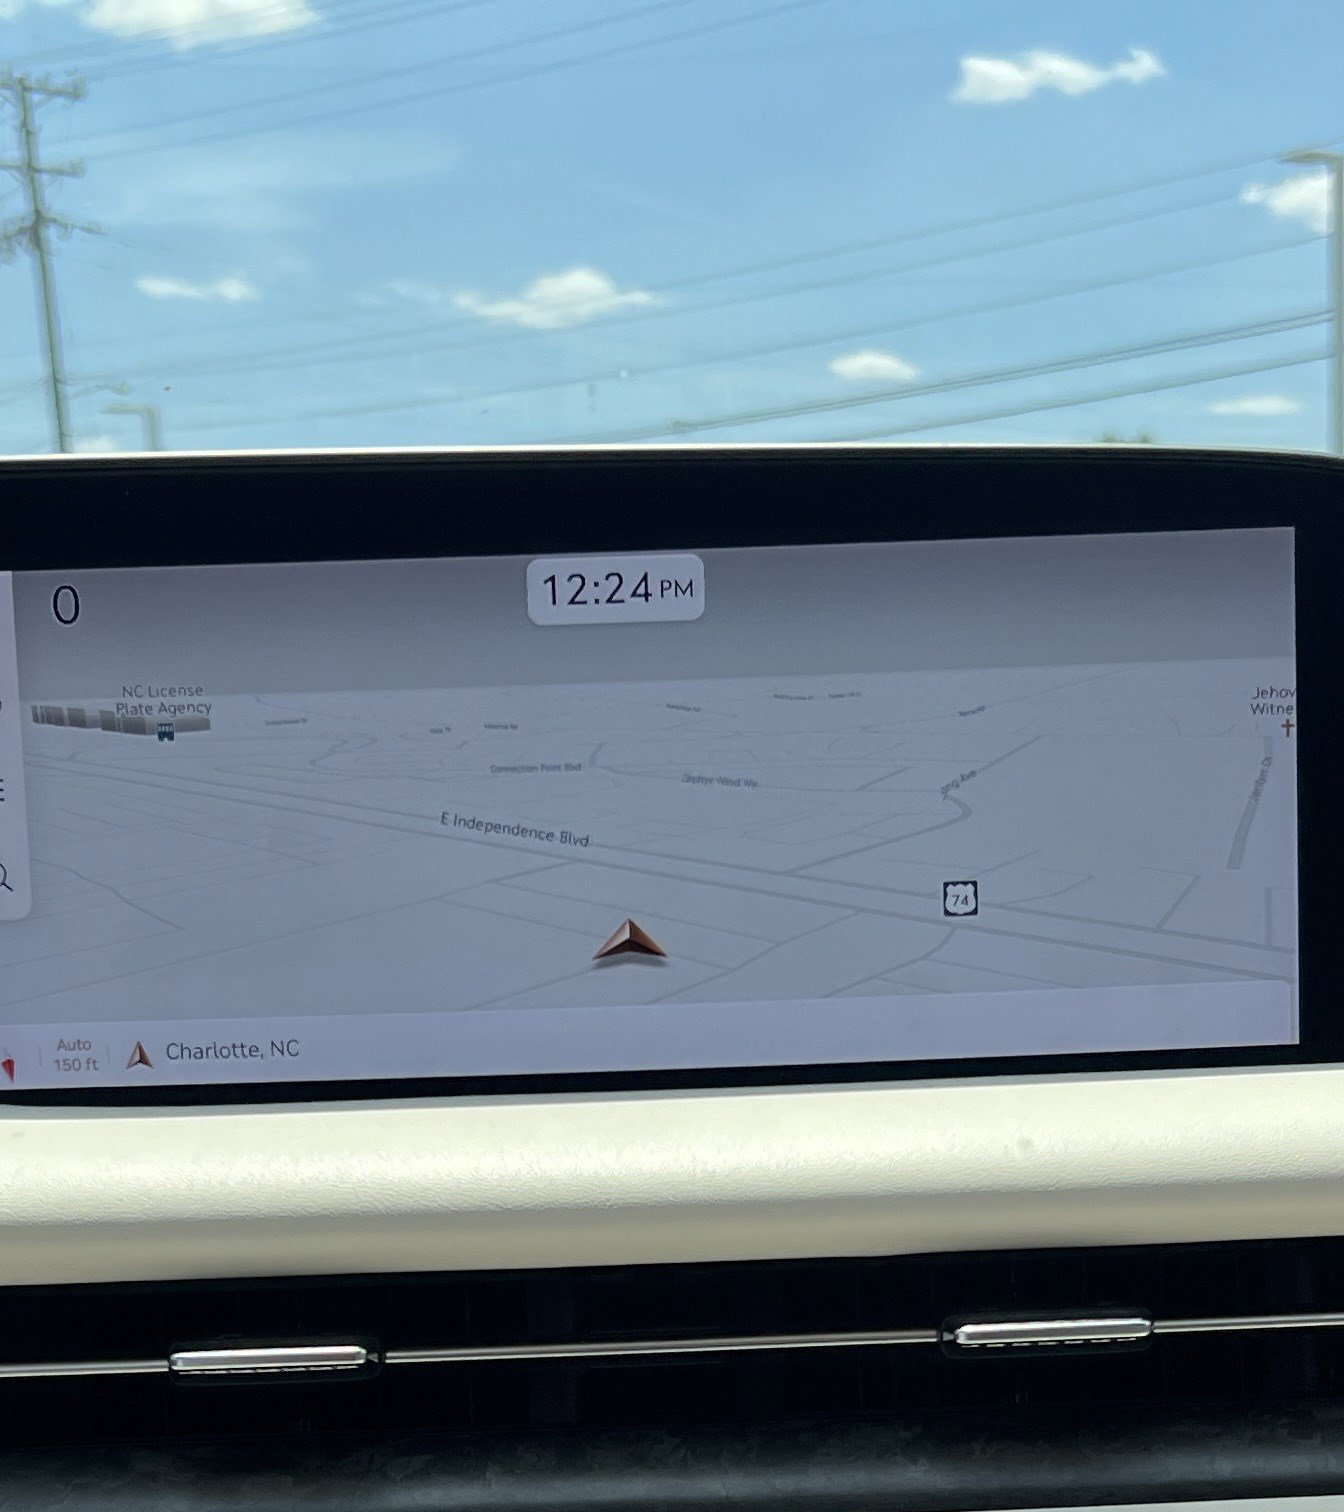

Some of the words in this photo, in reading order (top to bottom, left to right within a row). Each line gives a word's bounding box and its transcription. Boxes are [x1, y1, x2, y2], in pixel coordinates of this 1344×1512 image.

[543, 571, 653, 606] 12:24
[660, 578, 694, 599] PM
[53, 585, 80, 625] 0
[122, 685, 144, 698] NC
[148, 685, 204, 698] License
[116, 703, 153, 716] Plate
[158, 702, 212, 718] Agency
[440, 811, 450, 826] E
[453, 813, 555, 843] Independence
[559, 830, 591, 848] Blvd
[951, 894, 969, 907] 74
[57, 1038, 92, 1052] Auto
[165, 1041, 265, 1062] Charlotte,
[270, 1038, 301, 1057] NC
[54, 1058, 81, 1072] 150
[82, 1057, 99, 1071] ft
